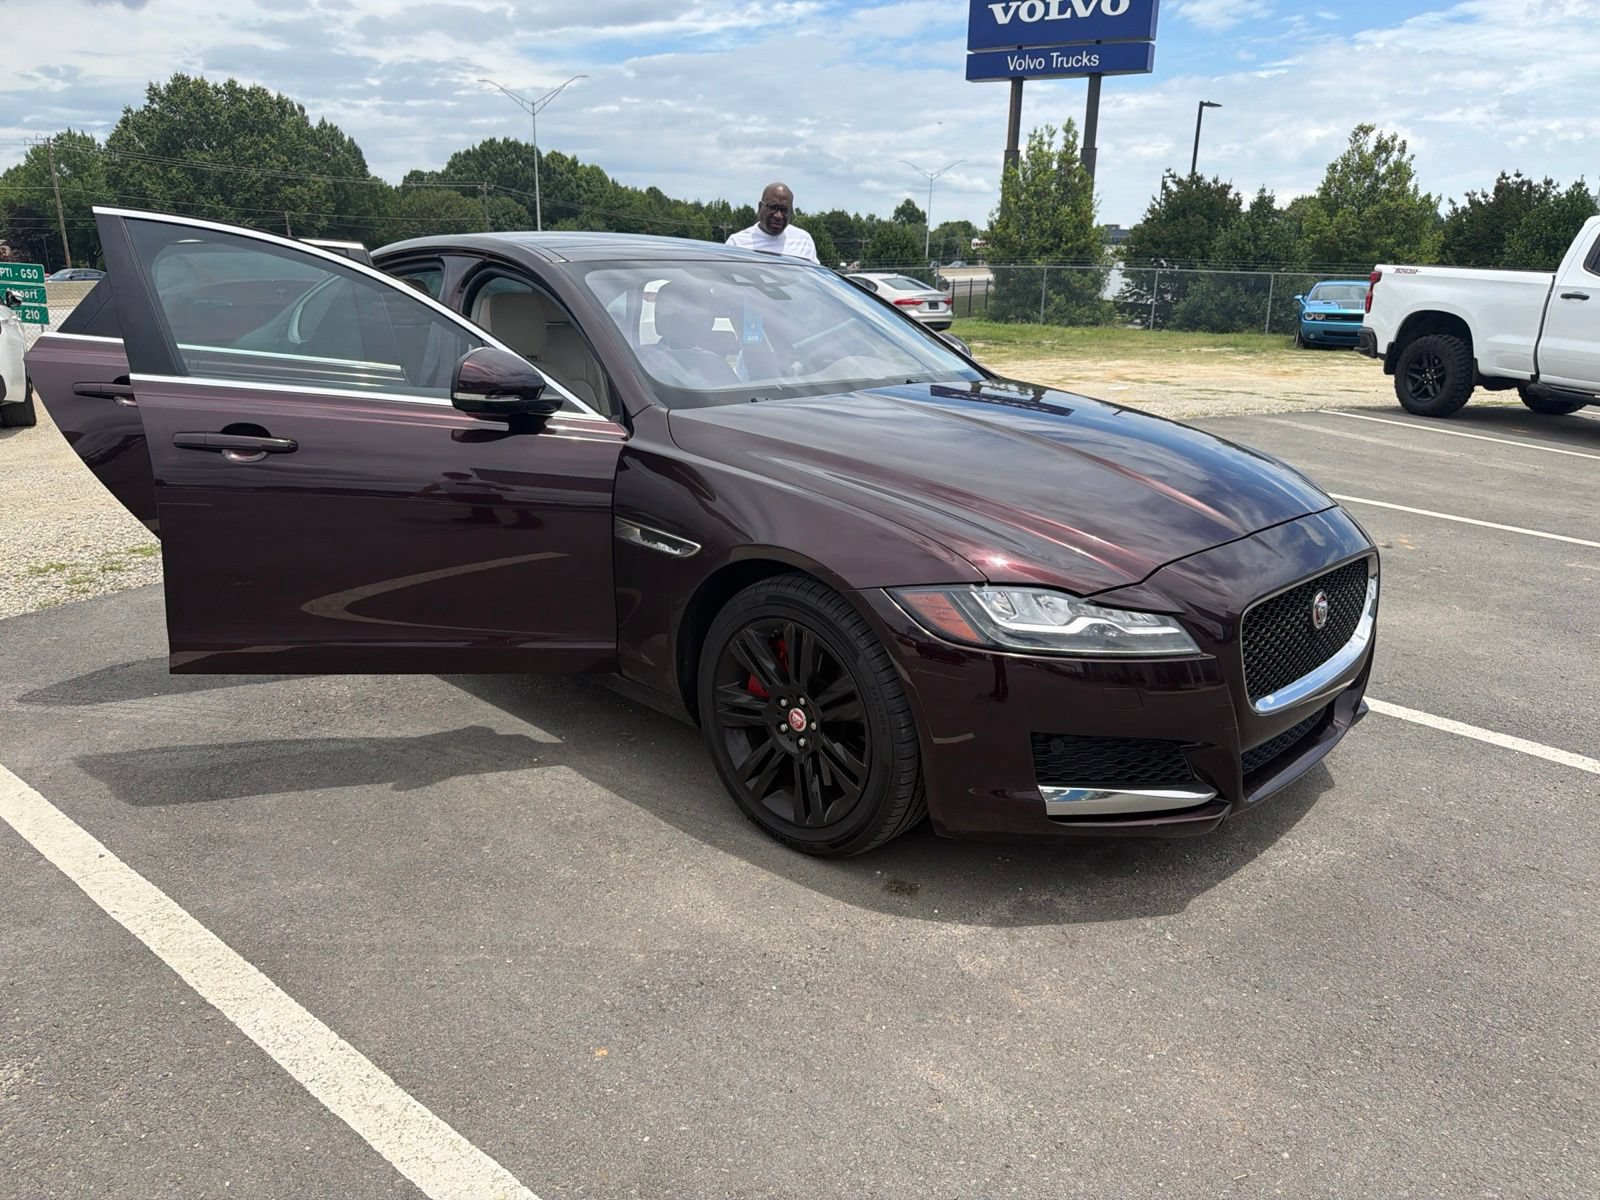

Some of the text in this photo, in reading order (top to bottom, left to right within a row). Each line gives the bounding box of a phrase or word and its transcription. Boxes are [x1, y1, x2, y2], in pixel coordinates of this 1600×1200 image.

[988, 0, 1130, 24] VOLVO
[1007, 51, 1100, 71] Volvo Trucks
[20, 269, 38, 279] GSO
[25, 310, 39, 319] 210
